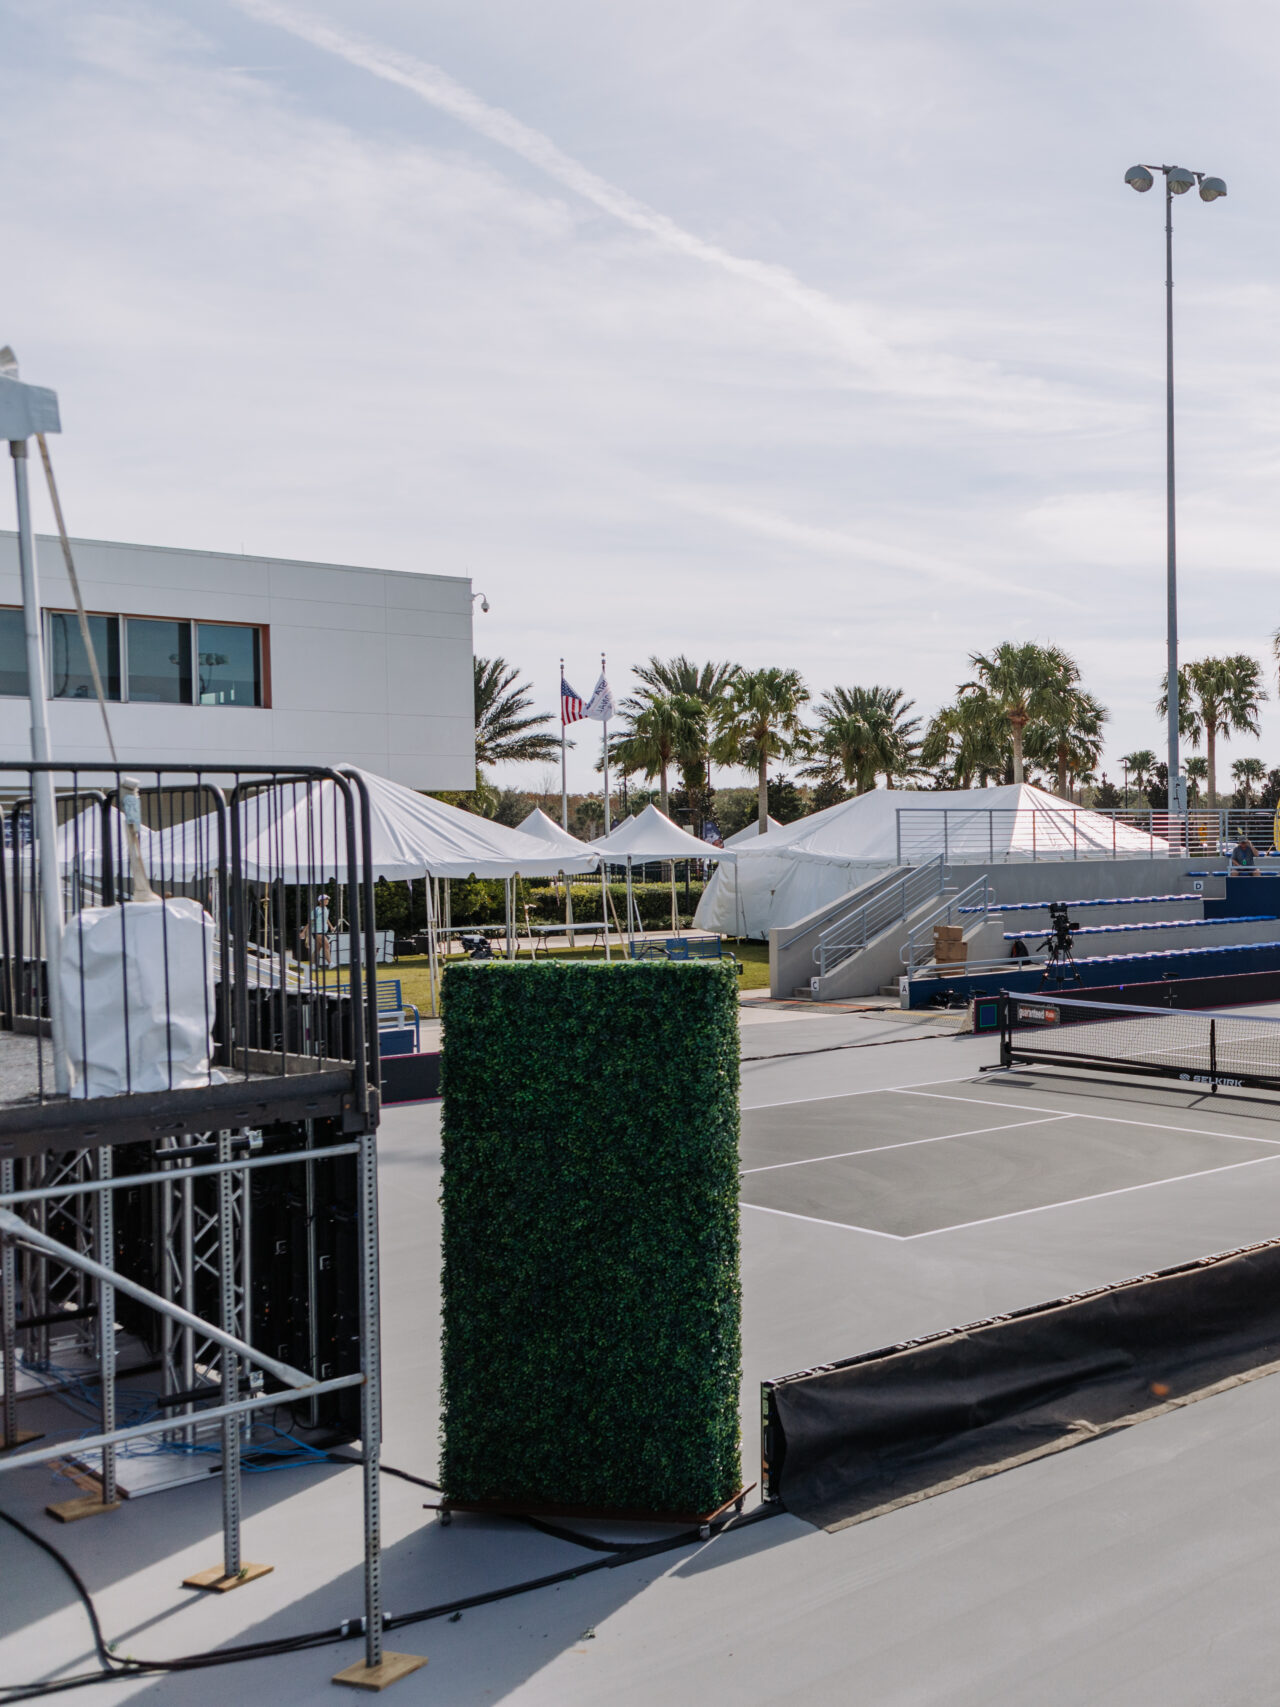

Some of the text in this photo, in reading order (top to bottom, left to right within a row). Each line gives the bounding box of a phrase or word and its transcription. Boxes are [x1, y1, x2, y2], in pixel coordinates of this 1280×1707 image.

[812, 981, 818, 990] C
[901, 985, 908, 993] A
[1193, 1075, 1243, 1088] SELKIRK
